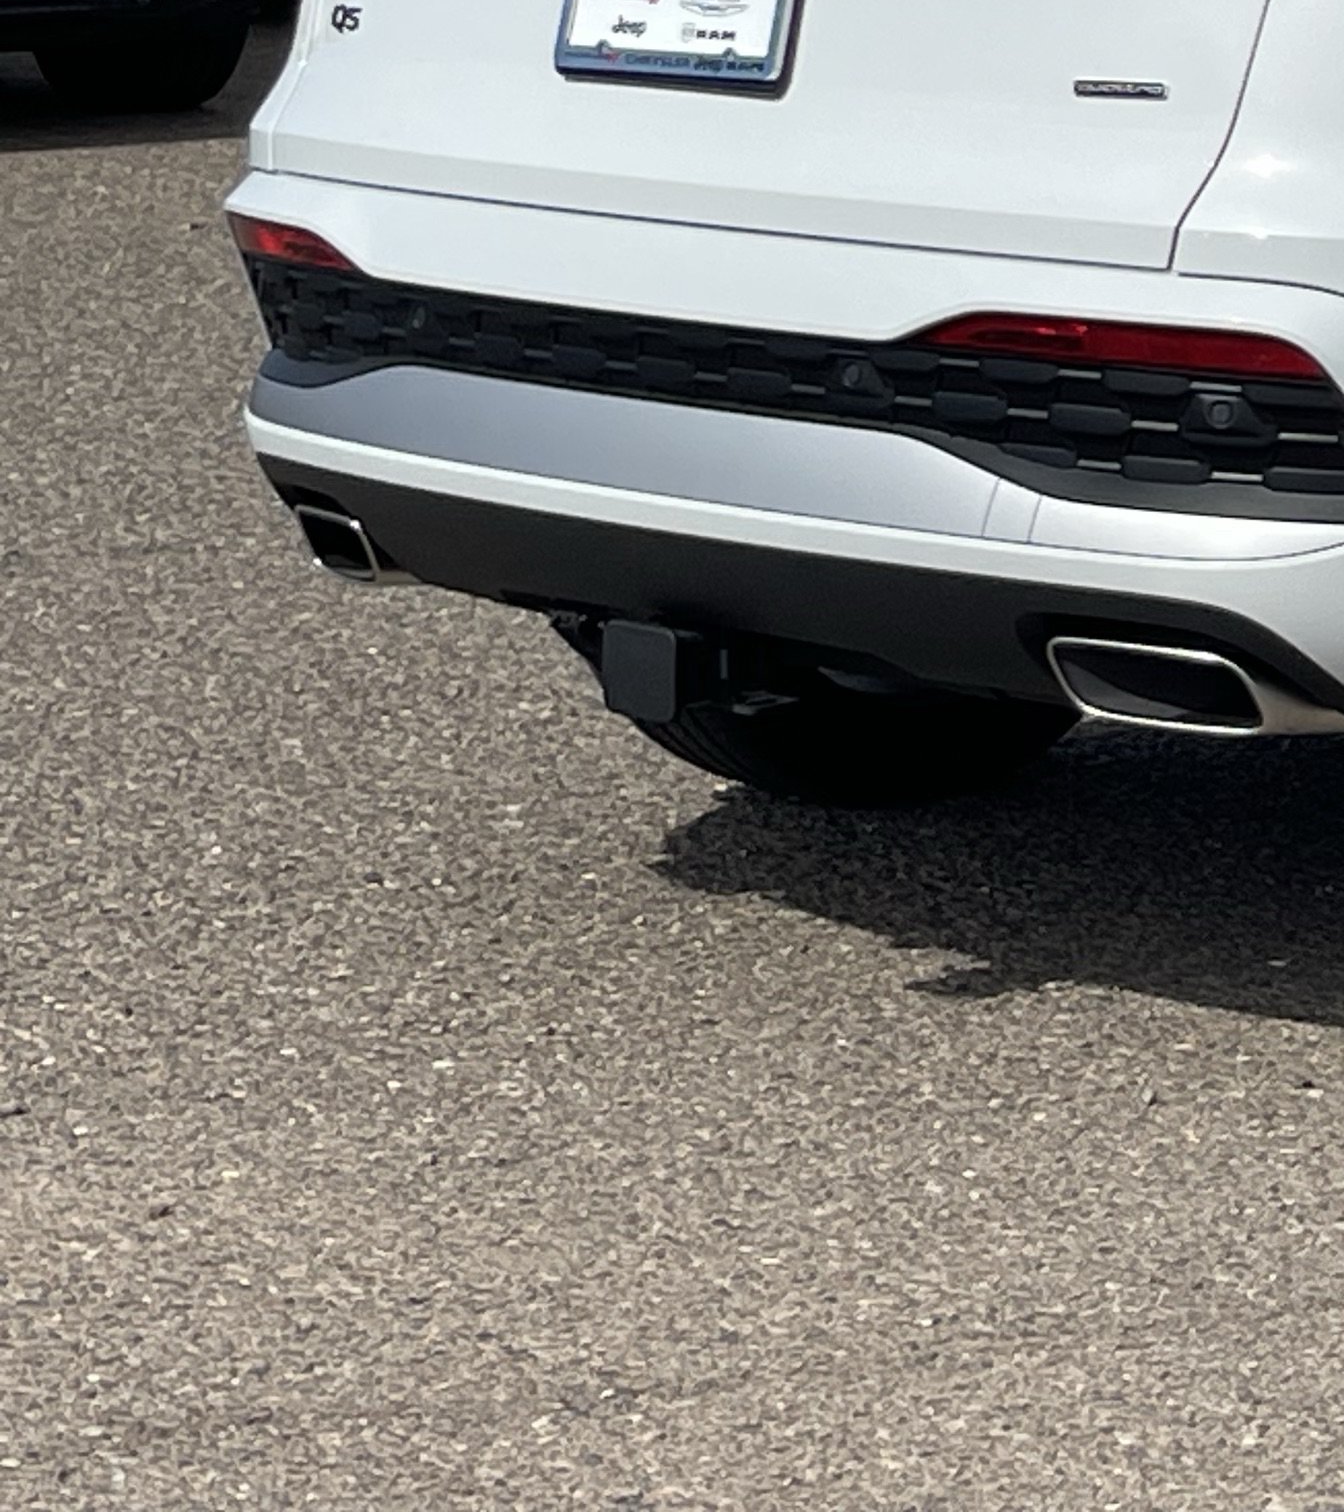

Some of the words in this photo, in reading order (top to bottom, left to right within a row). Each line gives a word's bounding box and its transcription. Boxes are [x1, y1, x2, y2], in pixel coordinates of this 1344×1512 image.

[331, 4, 363, 34] Q5
[611, 14, 648, 38] Jeep
[696, 29, 737, 40] RAM
